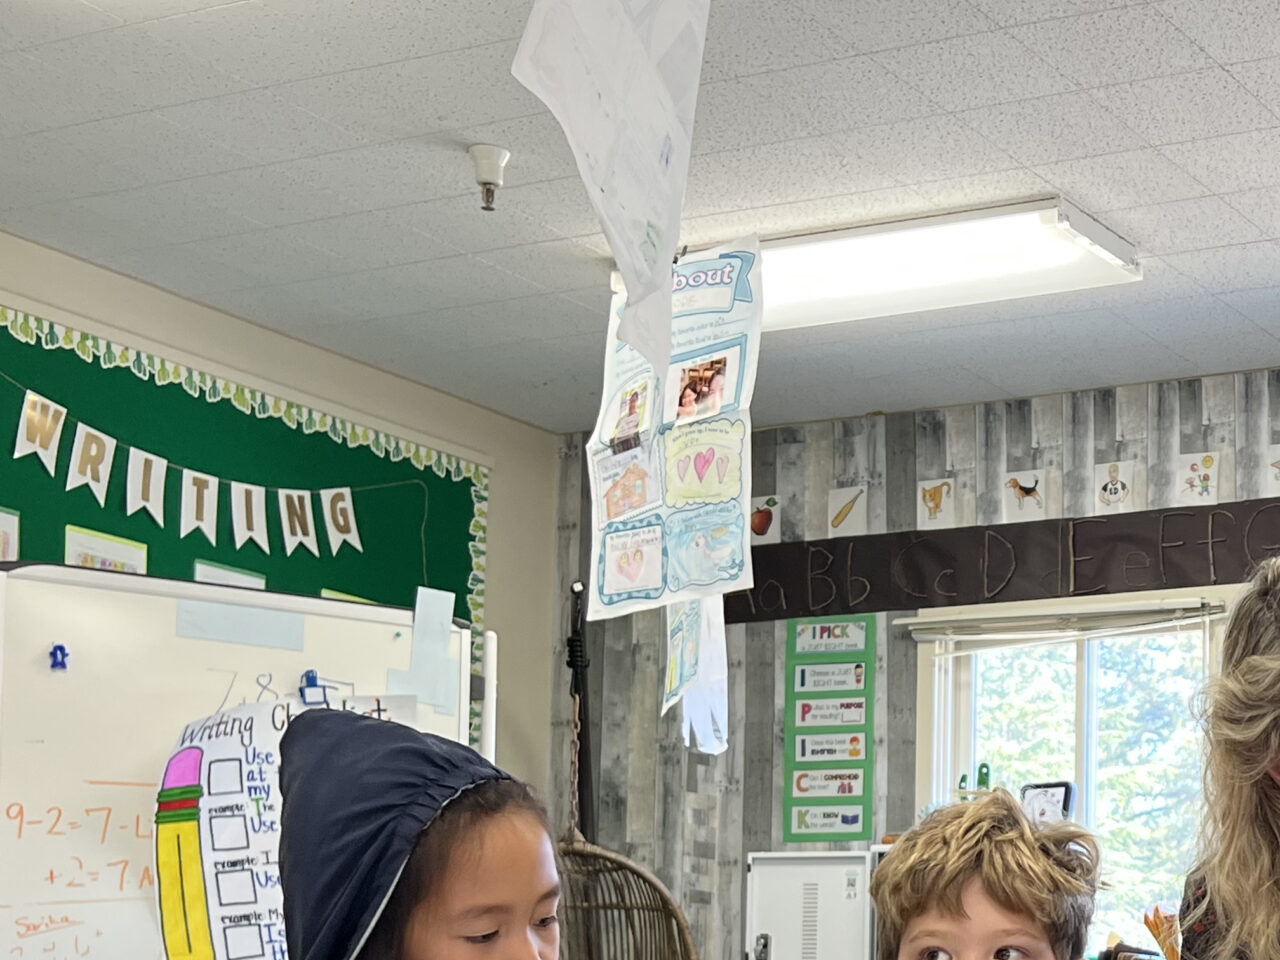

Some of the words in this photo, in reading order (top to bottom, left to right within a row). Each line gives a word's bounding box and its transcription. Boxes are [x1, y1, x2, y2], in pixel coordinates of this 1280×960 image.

[25, 396, 351, 537] WRITING
[820, 623, 850, 640] PICK
[180, 713, 255, 749] Writing
[245, 747, 275, 766] Use
[247, 766, 267, 783] at
[247, 785, 271, 802] my
[251, 816, 279, 834] Use
